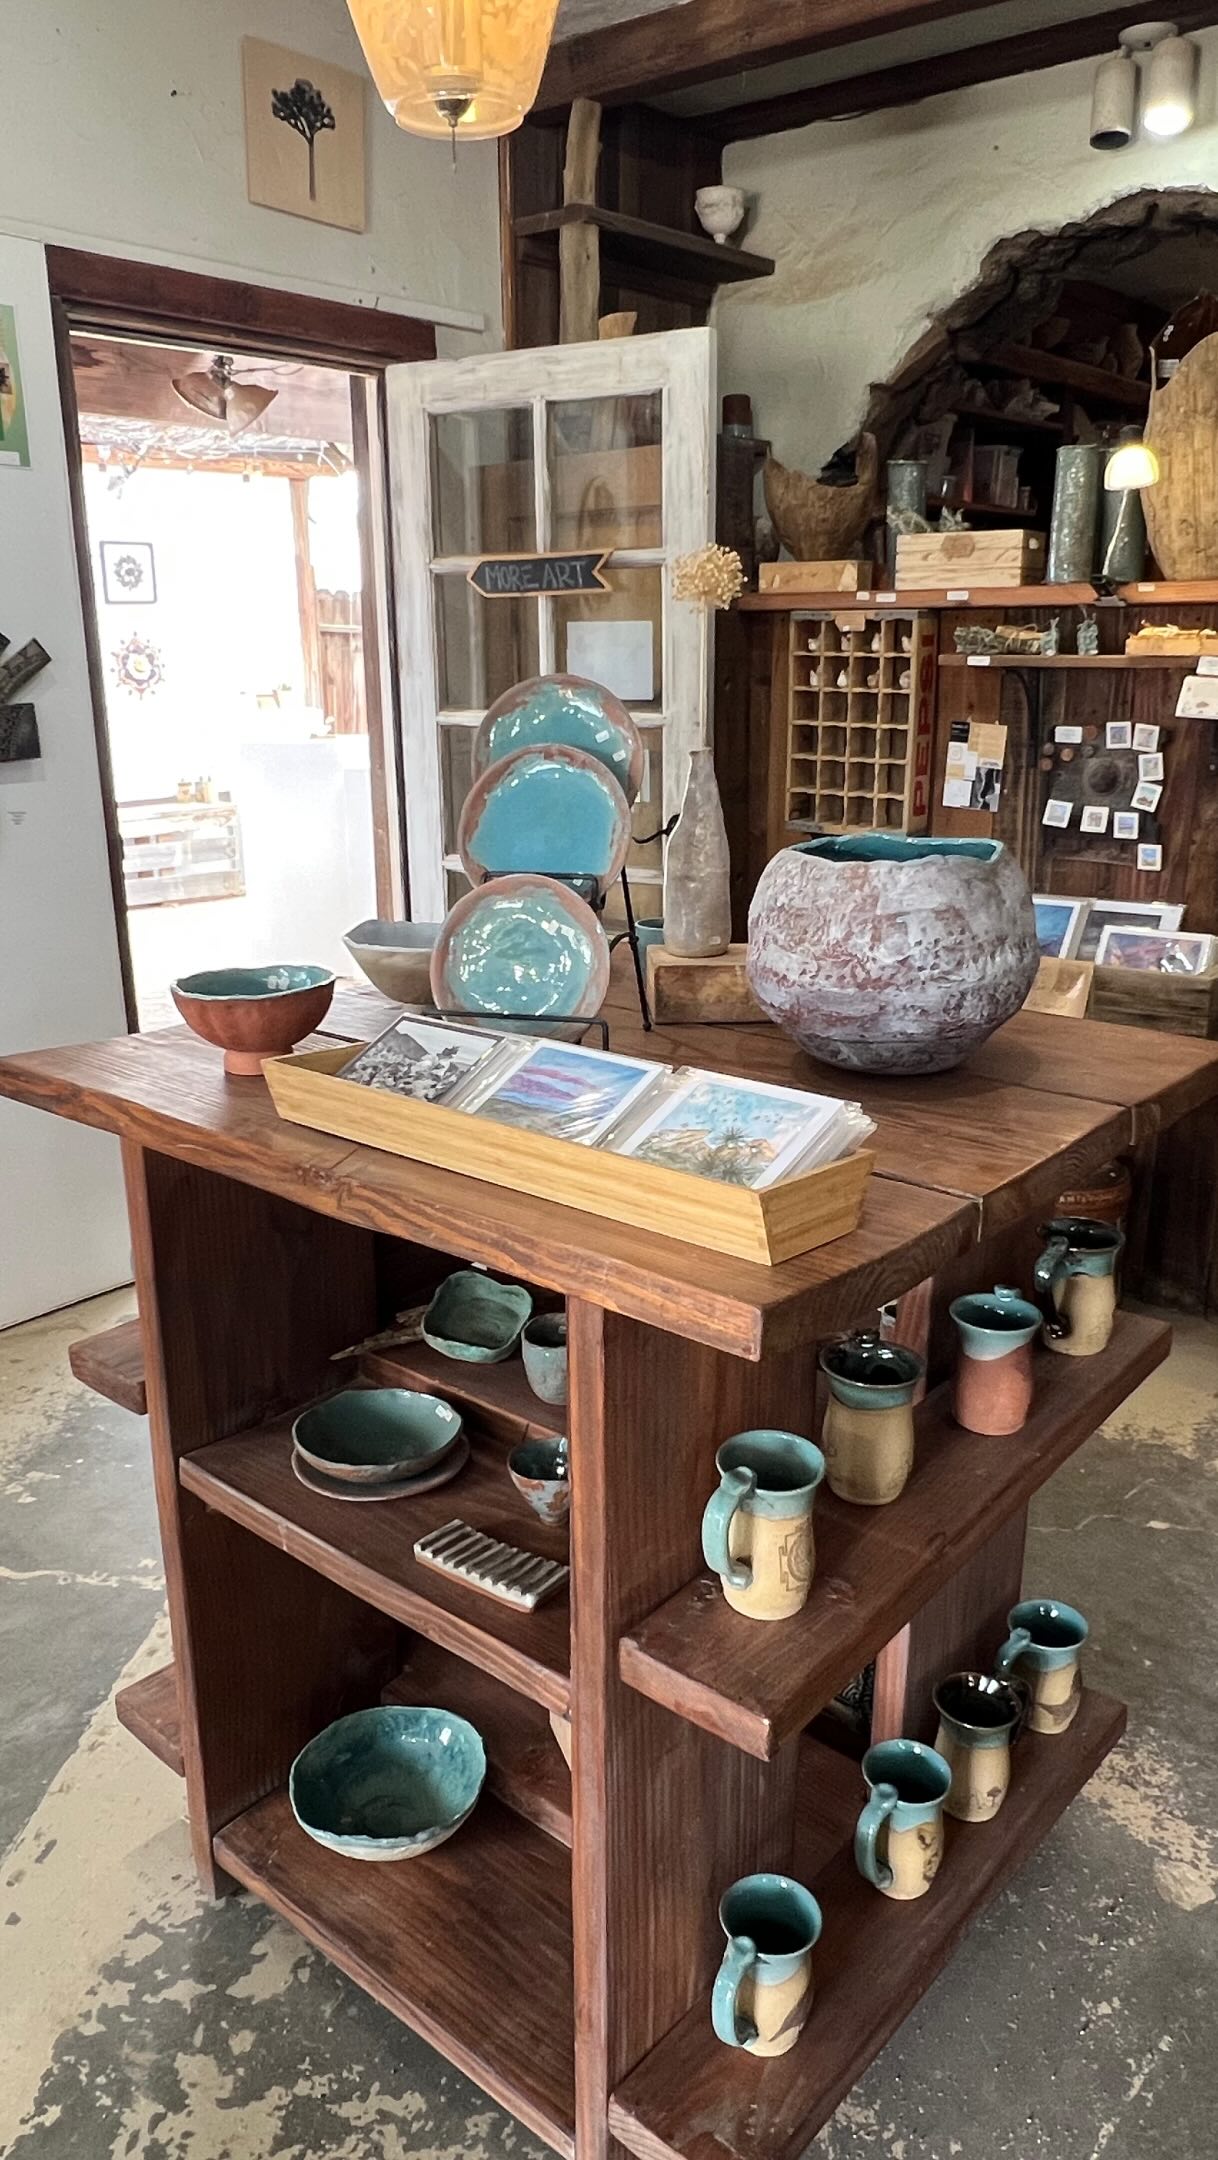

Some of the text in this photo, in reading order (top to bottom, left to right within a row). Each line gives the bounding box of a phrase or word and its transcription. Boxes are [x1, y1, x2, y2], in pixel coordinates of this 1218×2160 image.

[485, 561, 586, 591] MORE ART
[912, 634, 935, 817] PEPSI
